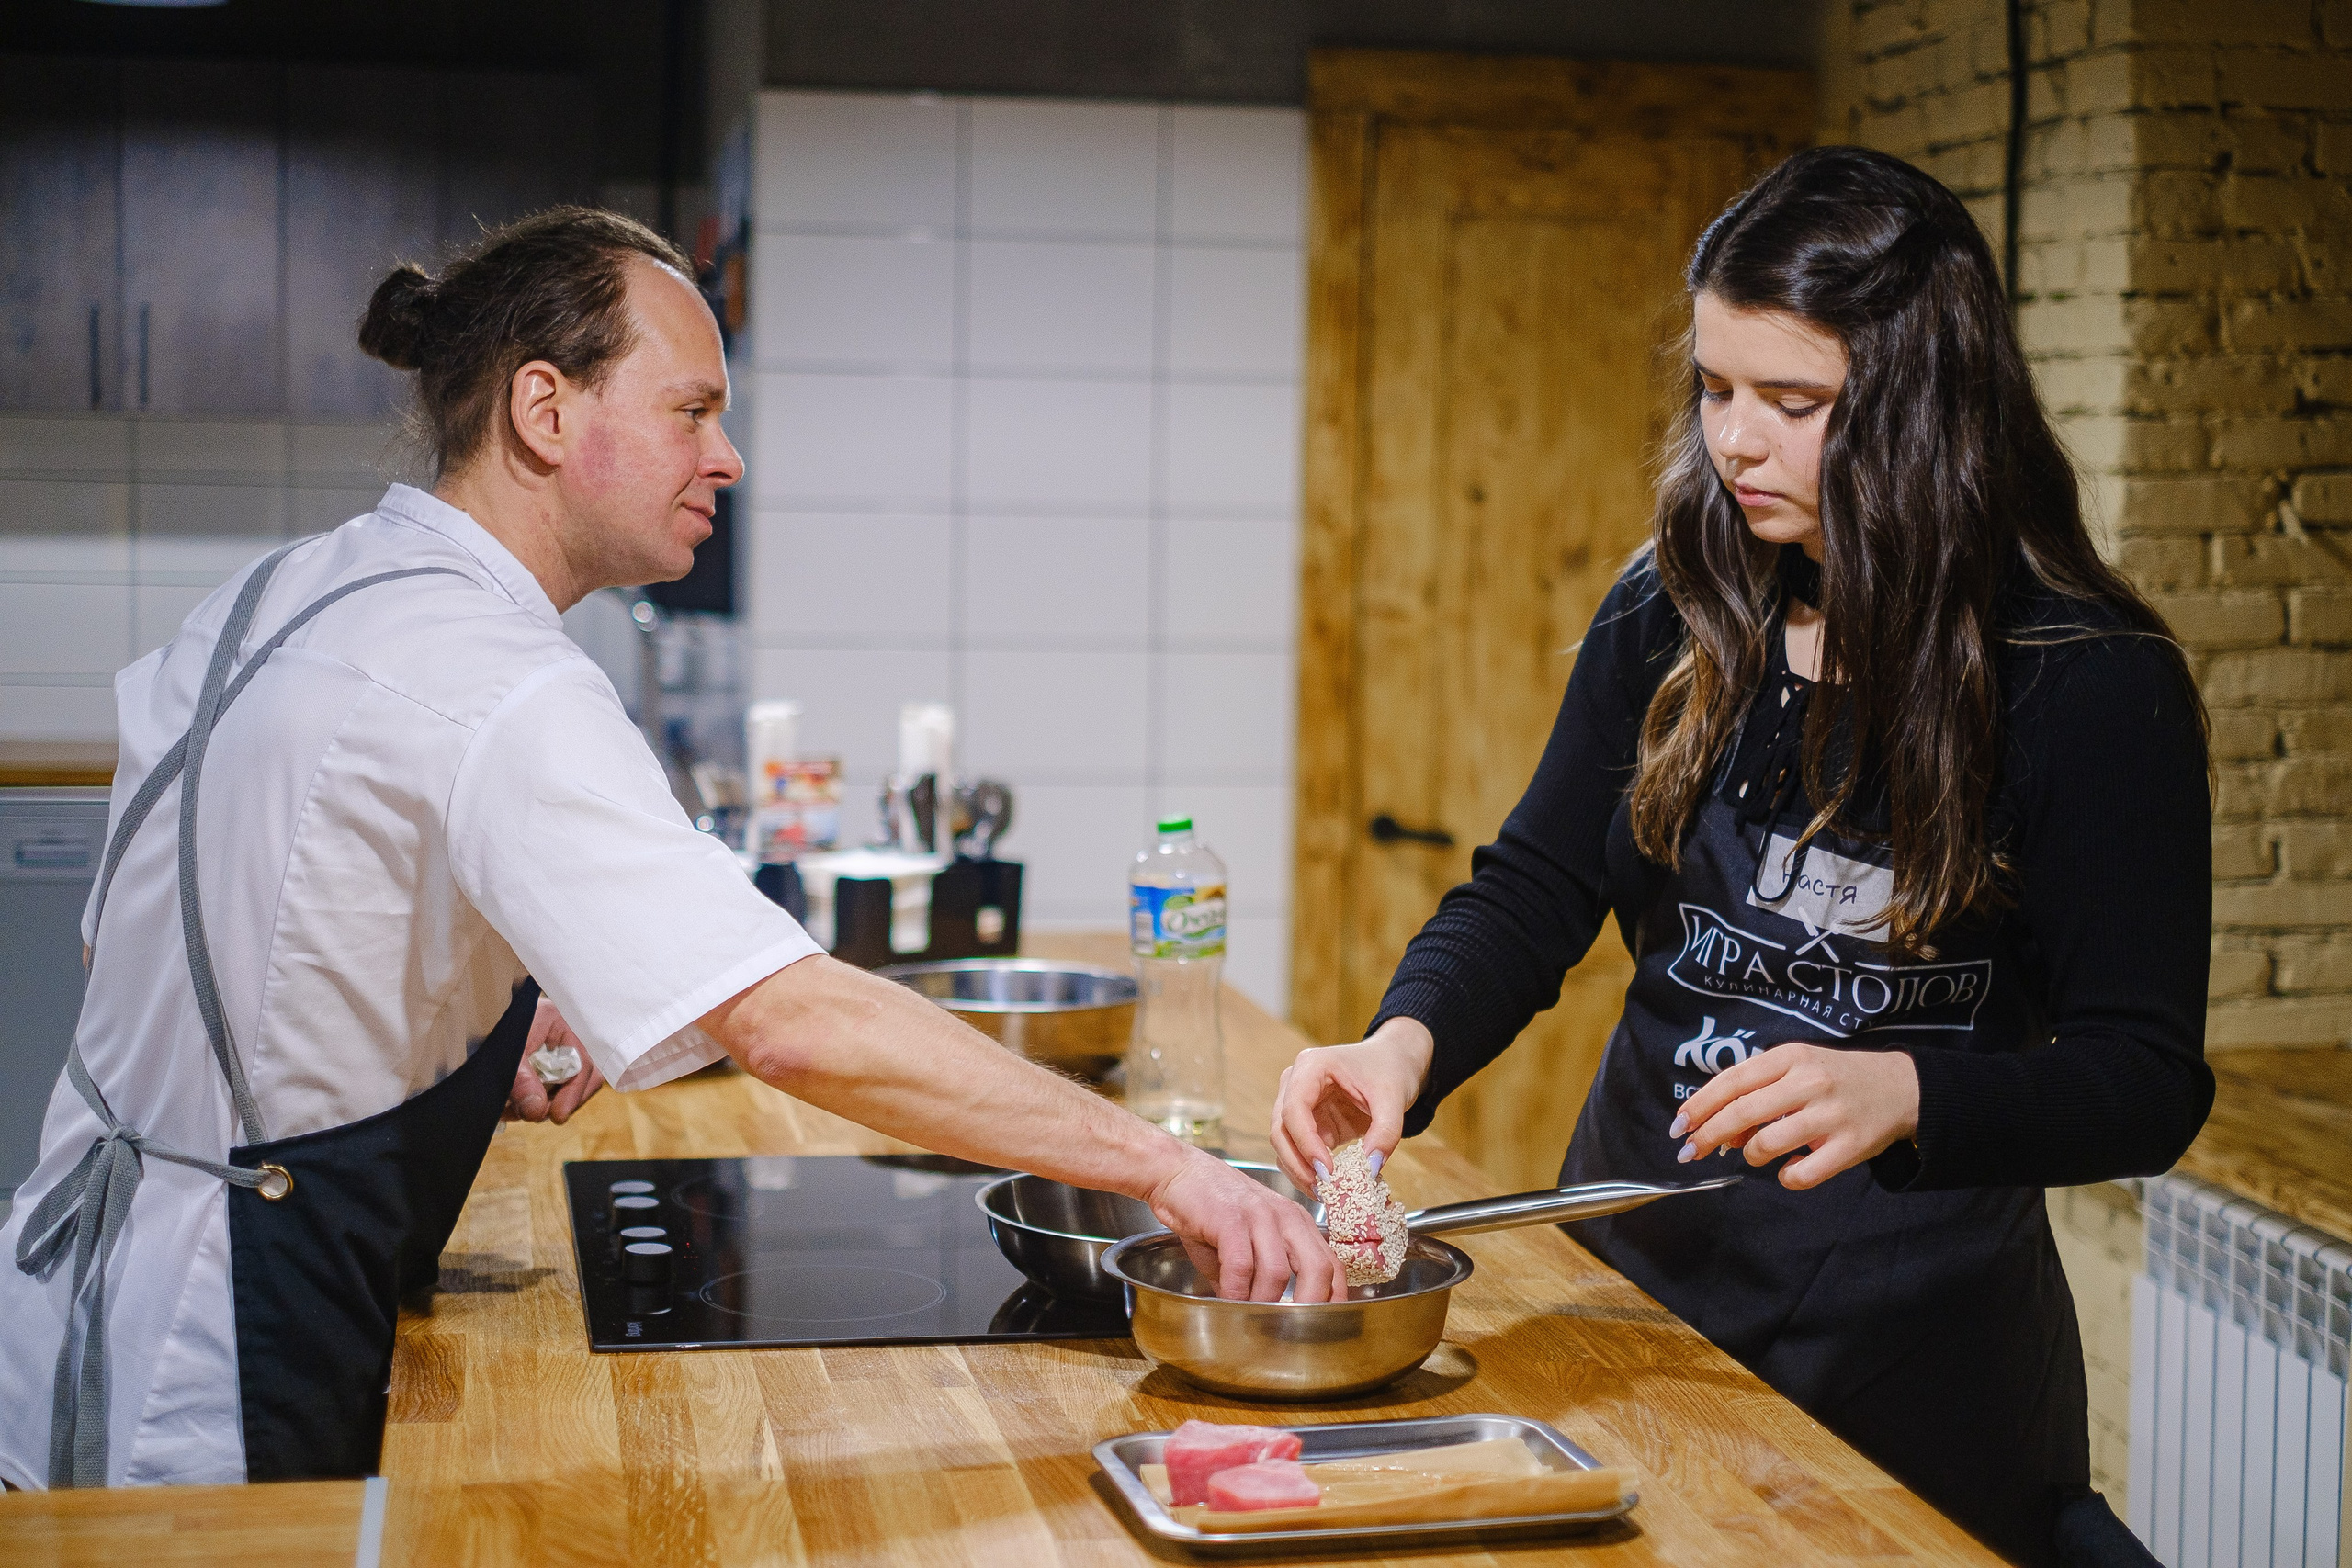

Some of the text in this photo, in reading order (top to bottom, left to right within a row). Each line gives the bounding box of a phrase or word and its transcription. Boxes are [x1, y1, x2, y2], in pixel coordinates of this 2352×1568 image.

[1690, 915, 1978, 1014] ИГРА СТОЛОВ
[1704, 975, 1834, 1018] КУЛИНАРНАЯ
